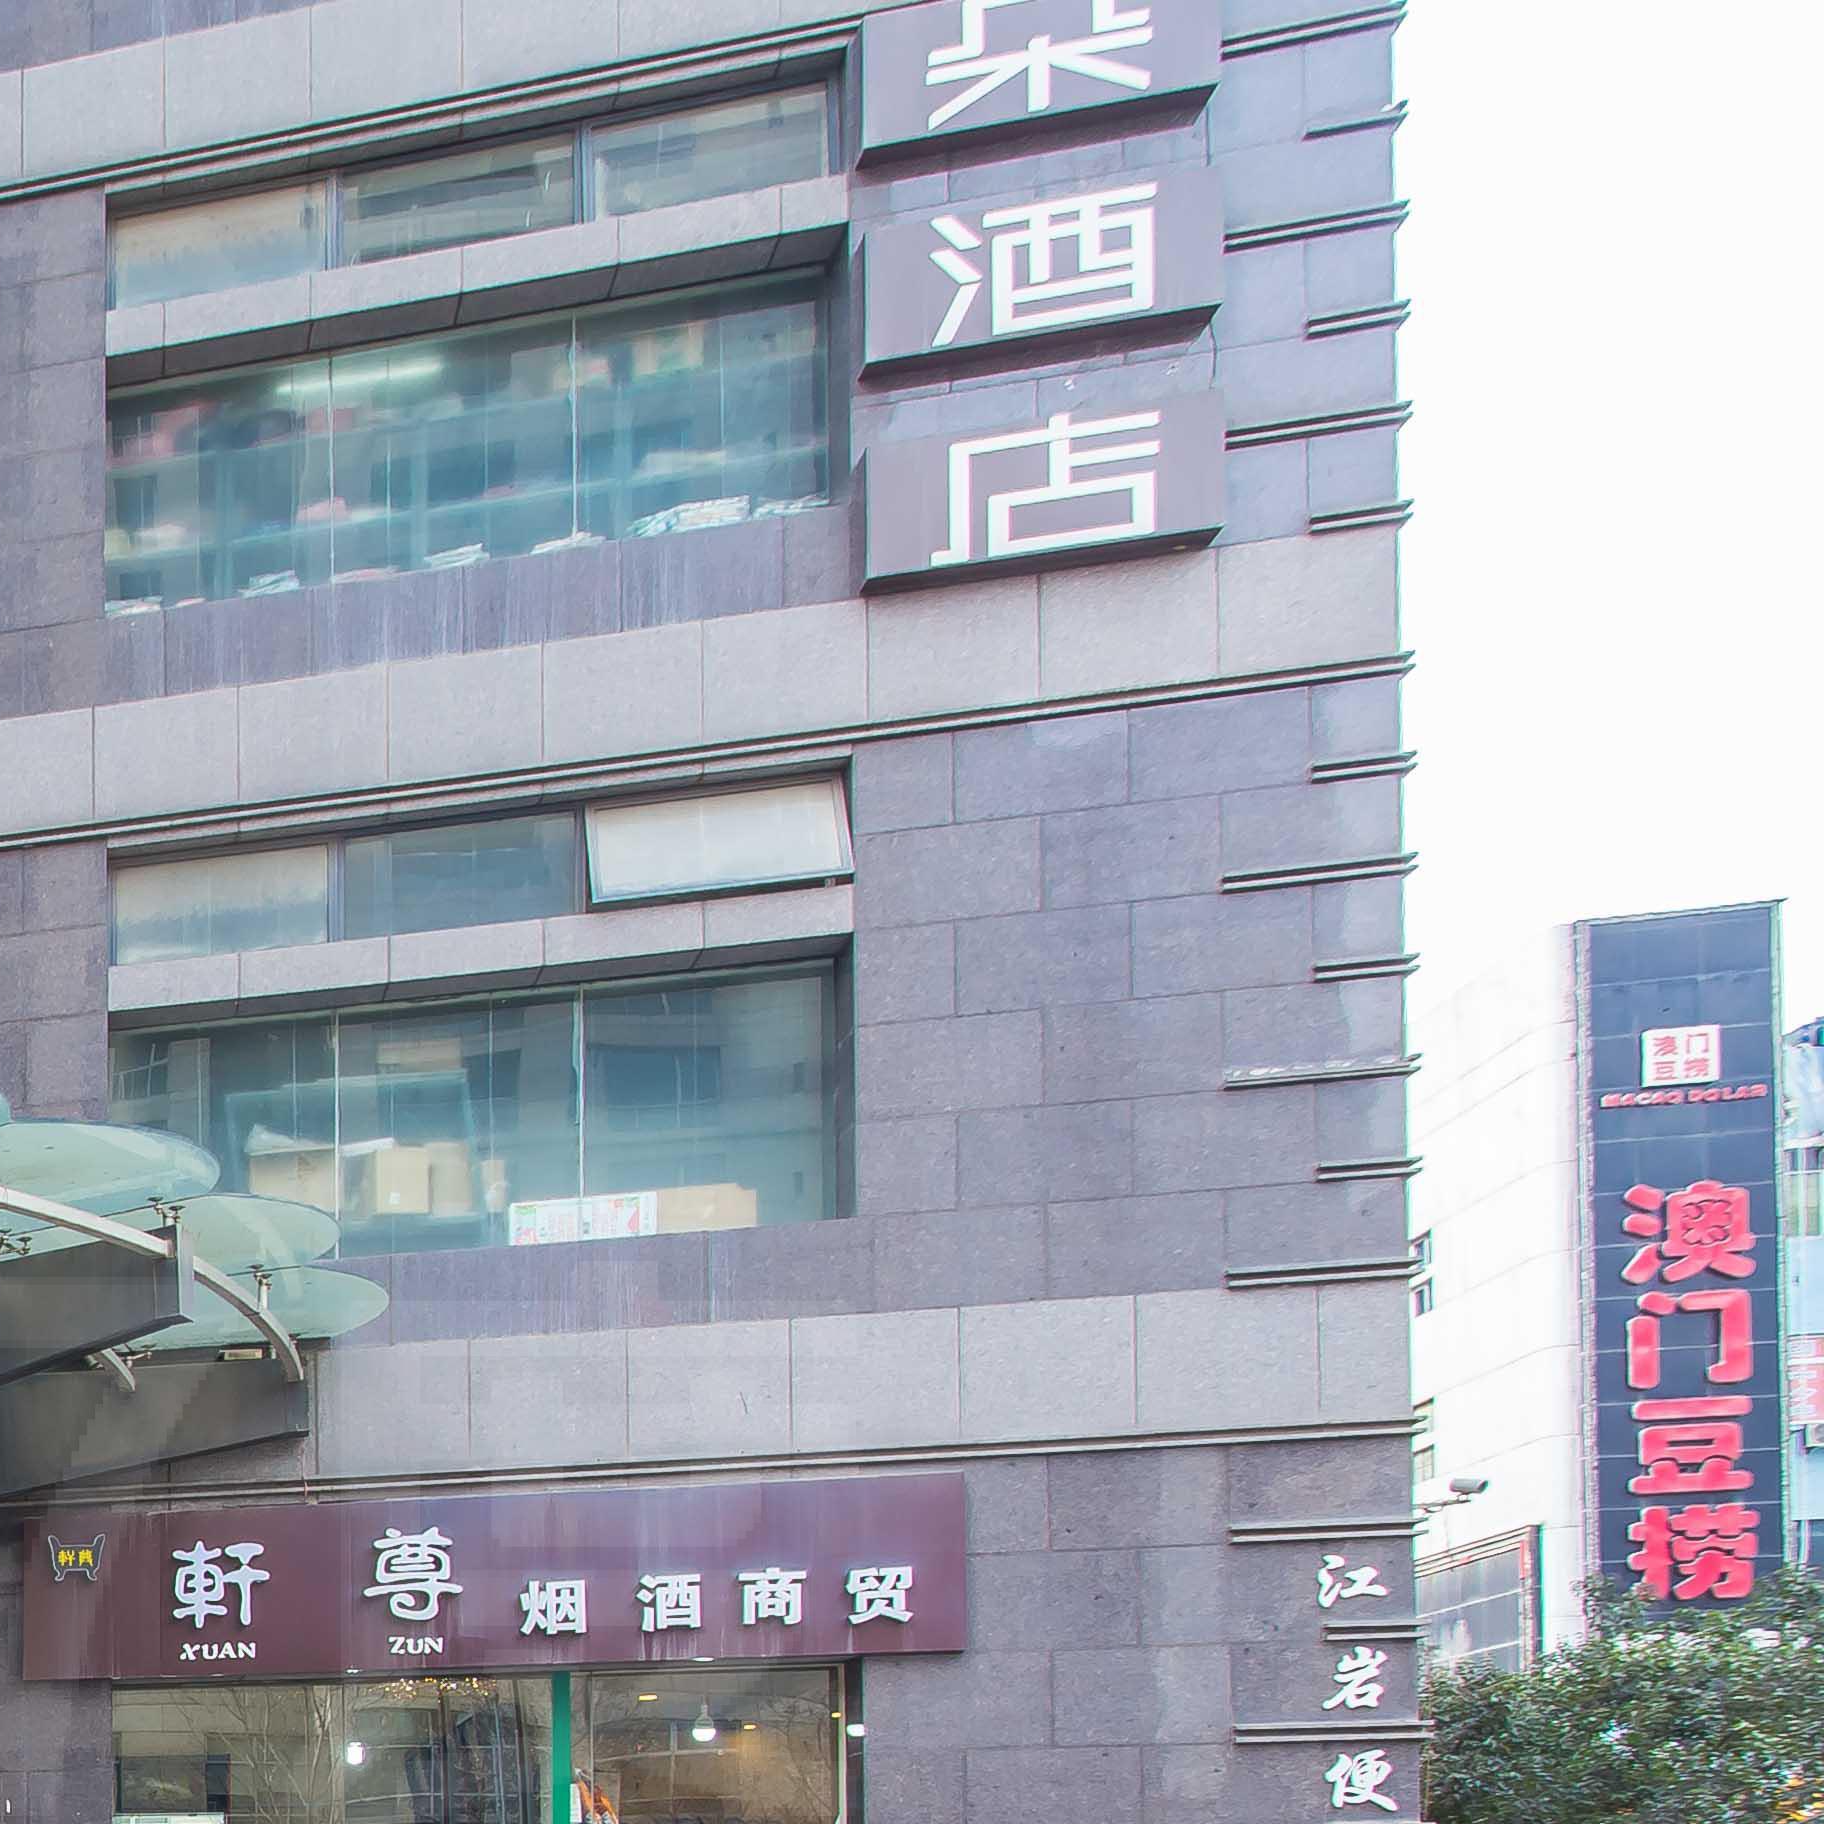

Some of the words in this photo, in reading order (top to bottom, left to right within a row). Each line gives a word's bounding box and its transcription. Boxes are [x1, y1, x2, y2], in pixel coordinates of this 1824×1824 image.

[1620, 1180, 1757, 1600] 澳门豆捞
[520, 1566, 913, 1636] 烟酒商贸
[179, 1641, 256, 1661] XUAN
[388, 1636, 444, 1654] ZUN
